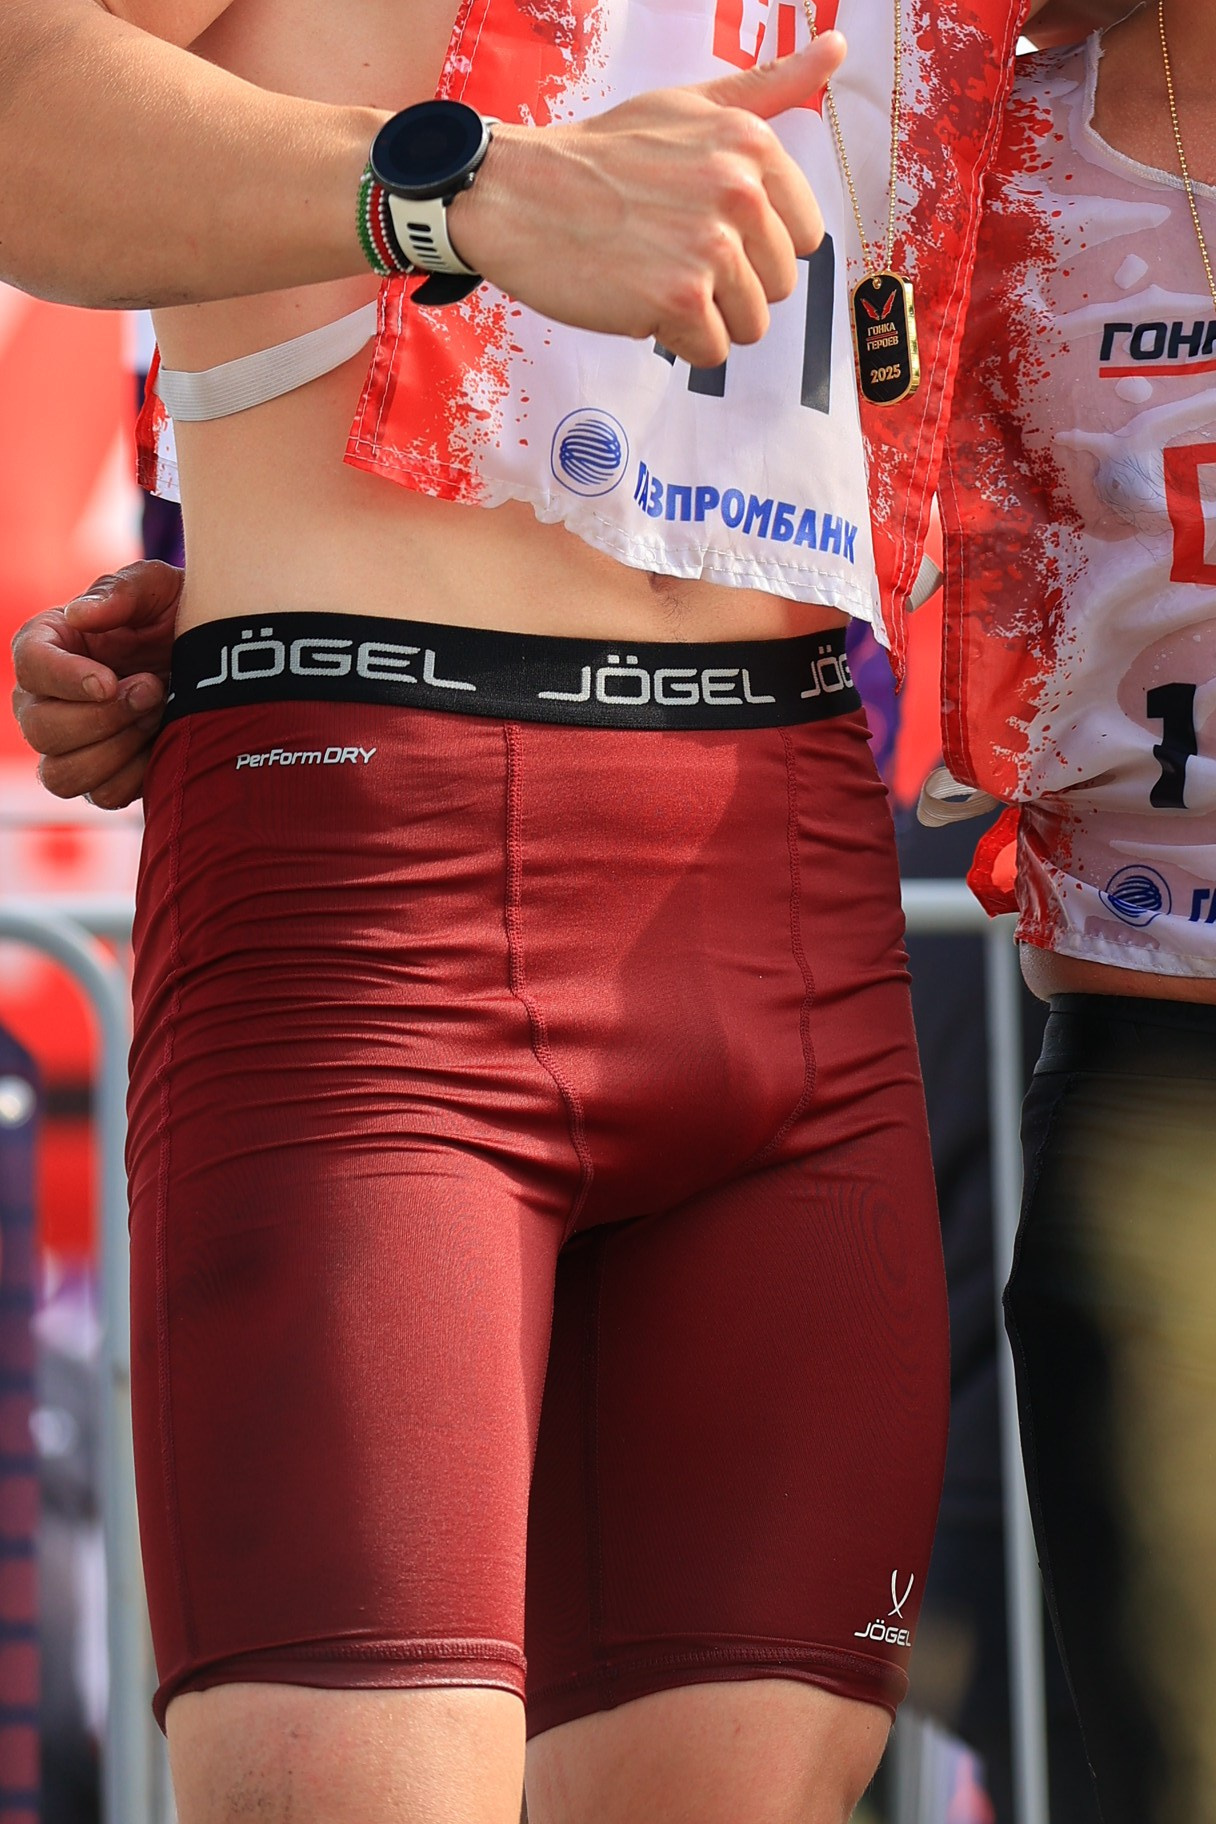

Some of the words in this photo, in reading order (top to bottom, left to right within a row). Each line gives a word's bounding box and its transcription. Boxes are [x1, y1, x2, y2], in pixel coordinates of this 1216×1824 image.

[868, 322, 896, 336] ГОНКА
[867, 336, 899, 351] ГЕРОЕВ
[871, 364, 901, 383] 2025
[634, 460, 858, 565] ГАЗПРОМБАНК
[196, 626, 477, 692] JÖGEL
[538, 653, 777, 706] JÖGEL
[854, 1619, 911, 1646] JÖGEL
